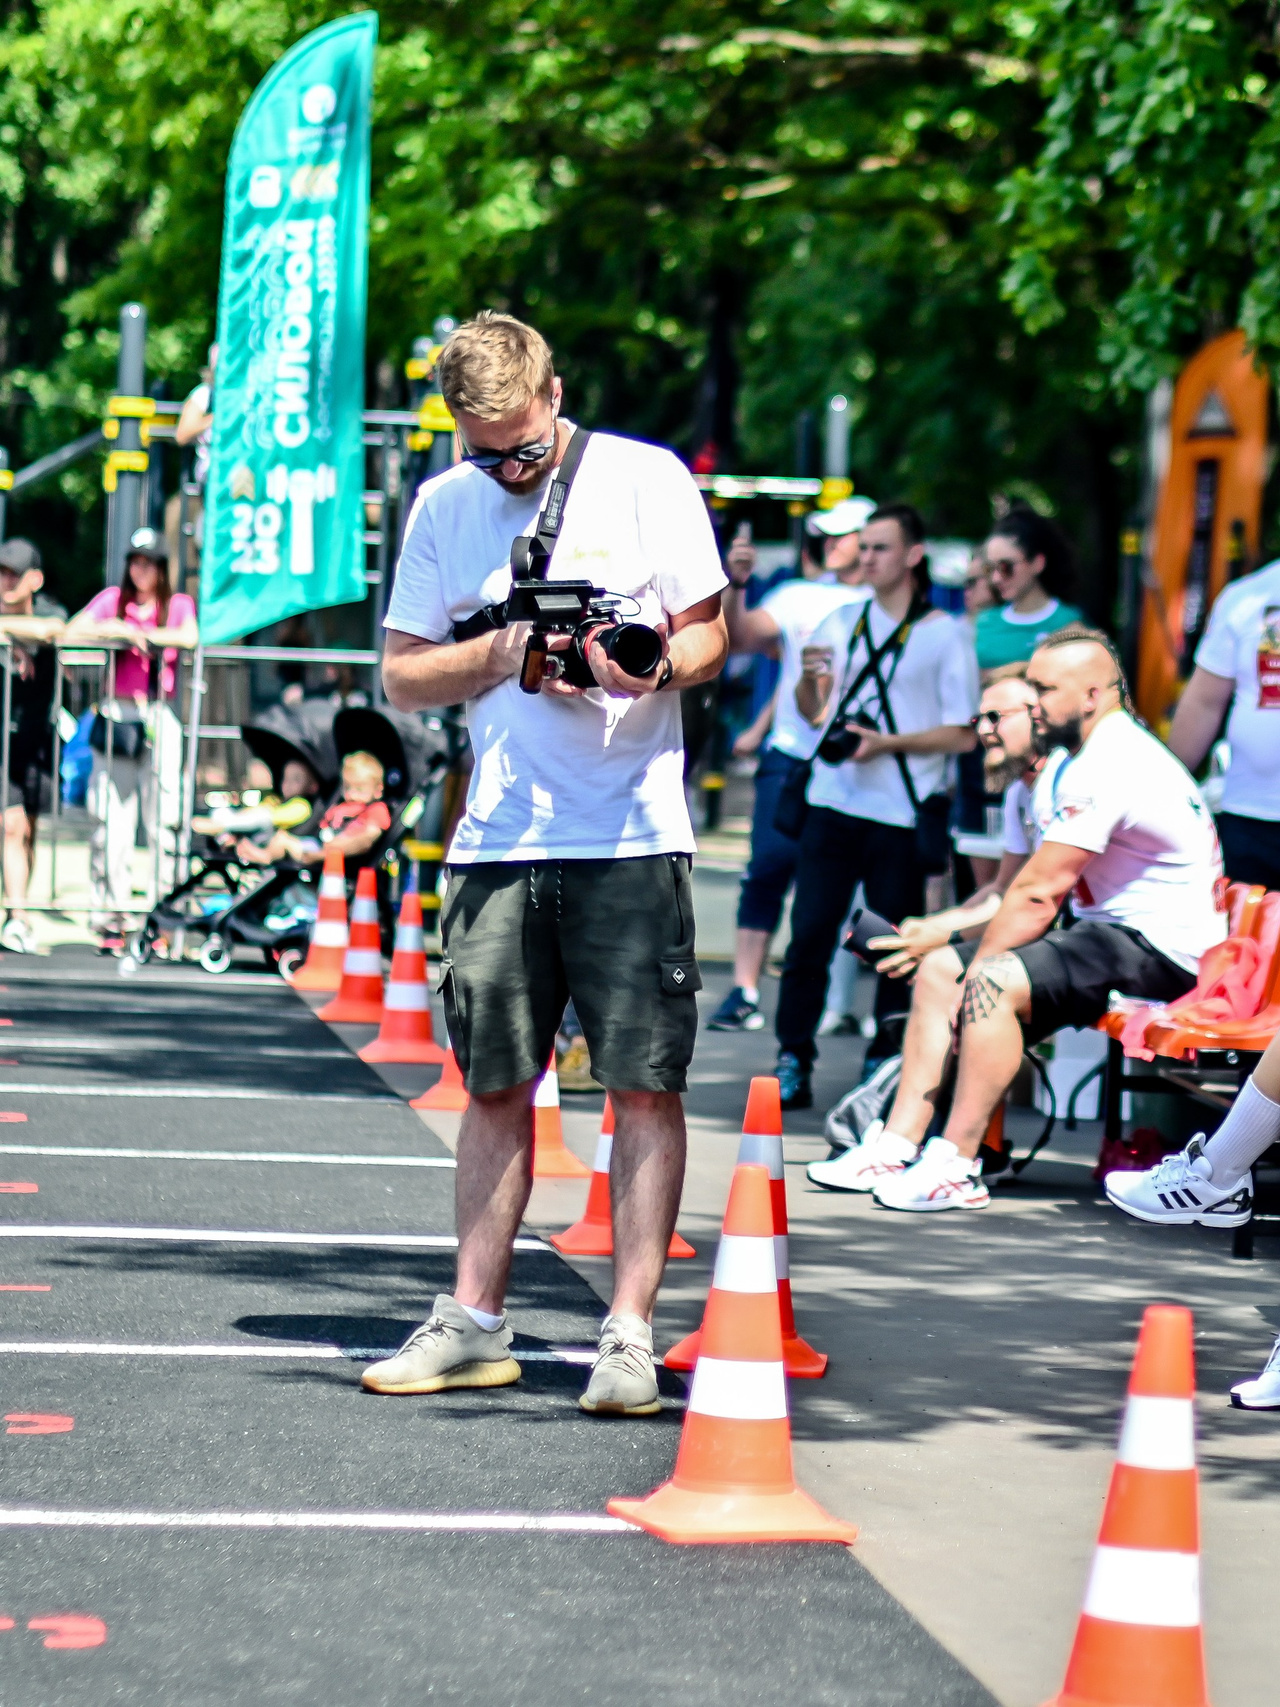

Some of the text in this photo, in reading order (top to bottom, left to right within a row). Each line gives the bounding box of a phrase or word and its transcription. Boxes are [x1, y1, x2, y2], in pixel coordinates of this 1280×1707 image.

[274, 219, 315, 448] СИЛОВОЙ
[231, 503, 282, 539] 20
[230, 540, 280, 574] 23
